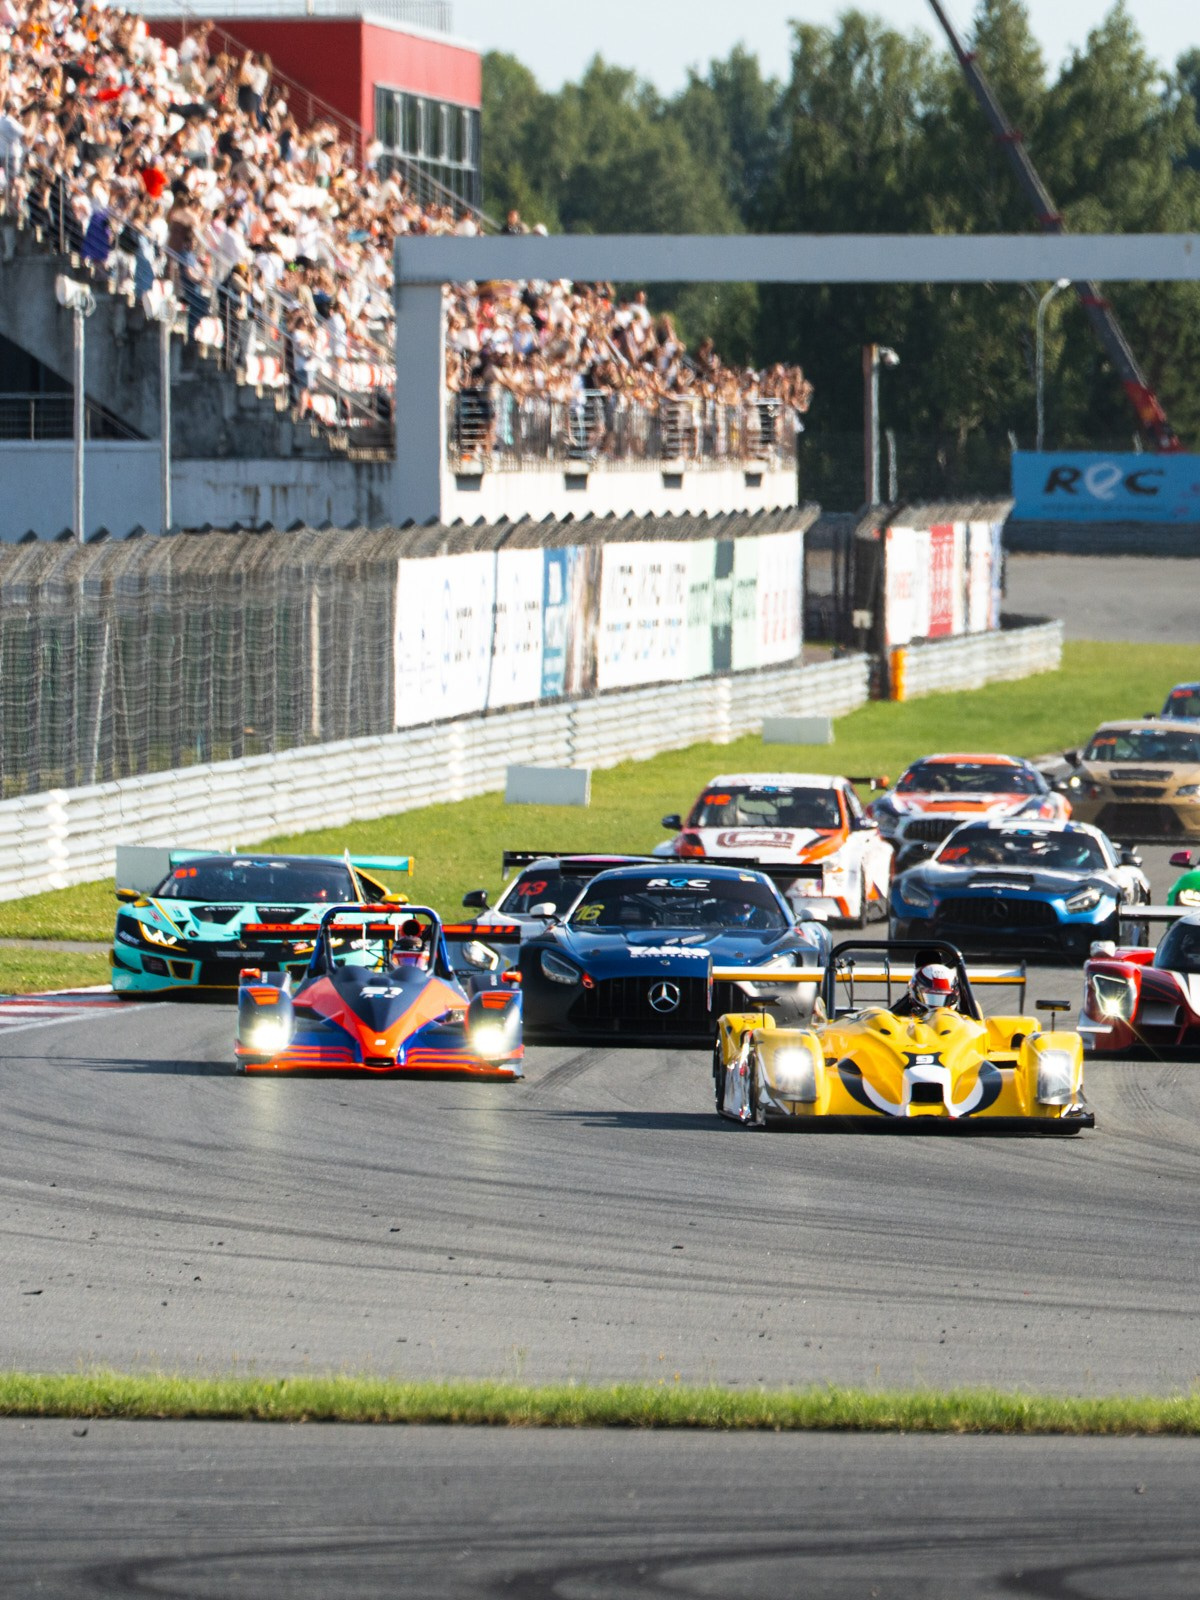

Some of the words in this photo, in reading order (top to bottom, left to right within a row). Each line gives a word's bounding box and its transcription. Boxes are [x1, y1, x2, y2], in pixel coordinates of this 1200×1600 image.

[517, 880, 549, 897] 13
[573, 904, 605, 921] 16
[915, 1054, 935, 1065] 9
